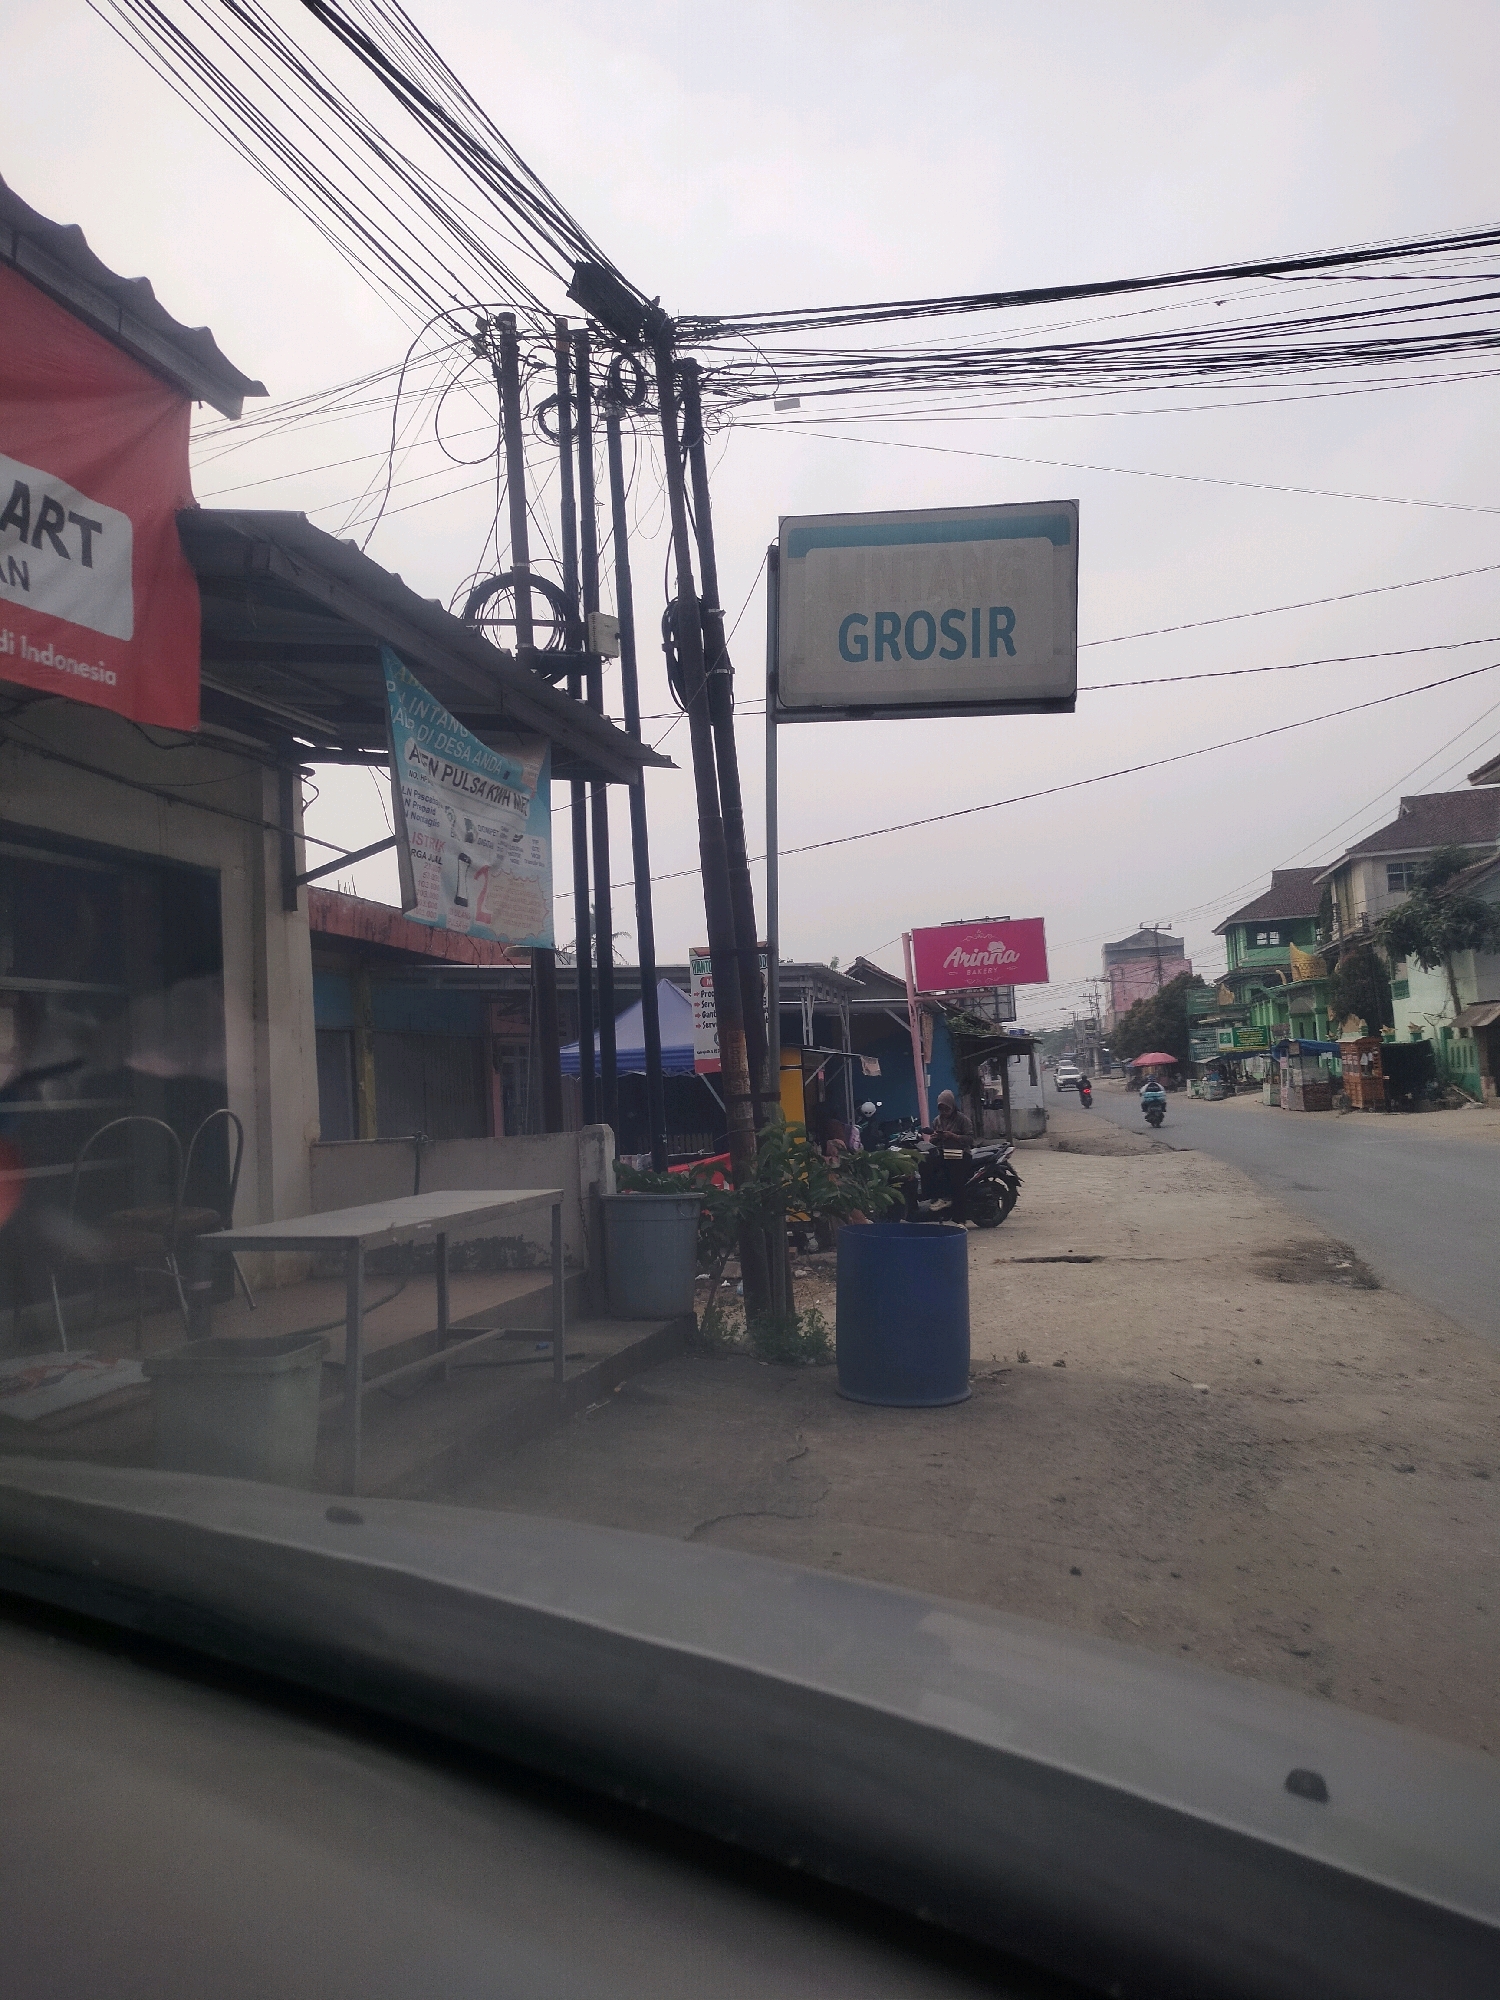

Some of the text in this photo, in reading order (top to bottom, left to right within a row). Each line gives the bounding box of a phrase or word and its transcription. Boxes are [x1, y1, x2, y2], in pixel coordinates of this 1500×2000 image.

[838, 606, 1018, 663] GROSIR
[20, 635, 117, 686] Indonesia
[417, 725, 434, 745] DI
[434, 733, 474, 762] DESA
[472, 750, 502, 774] ANDA
[441, 764, 484, 798] PULSA
[486, 784, 511, 807] KWH
[411, 832, 446, 853] ISTRIK
[943, 945, 1020, 969] Arinna
[967, 967, 998, 976] BAKERY
